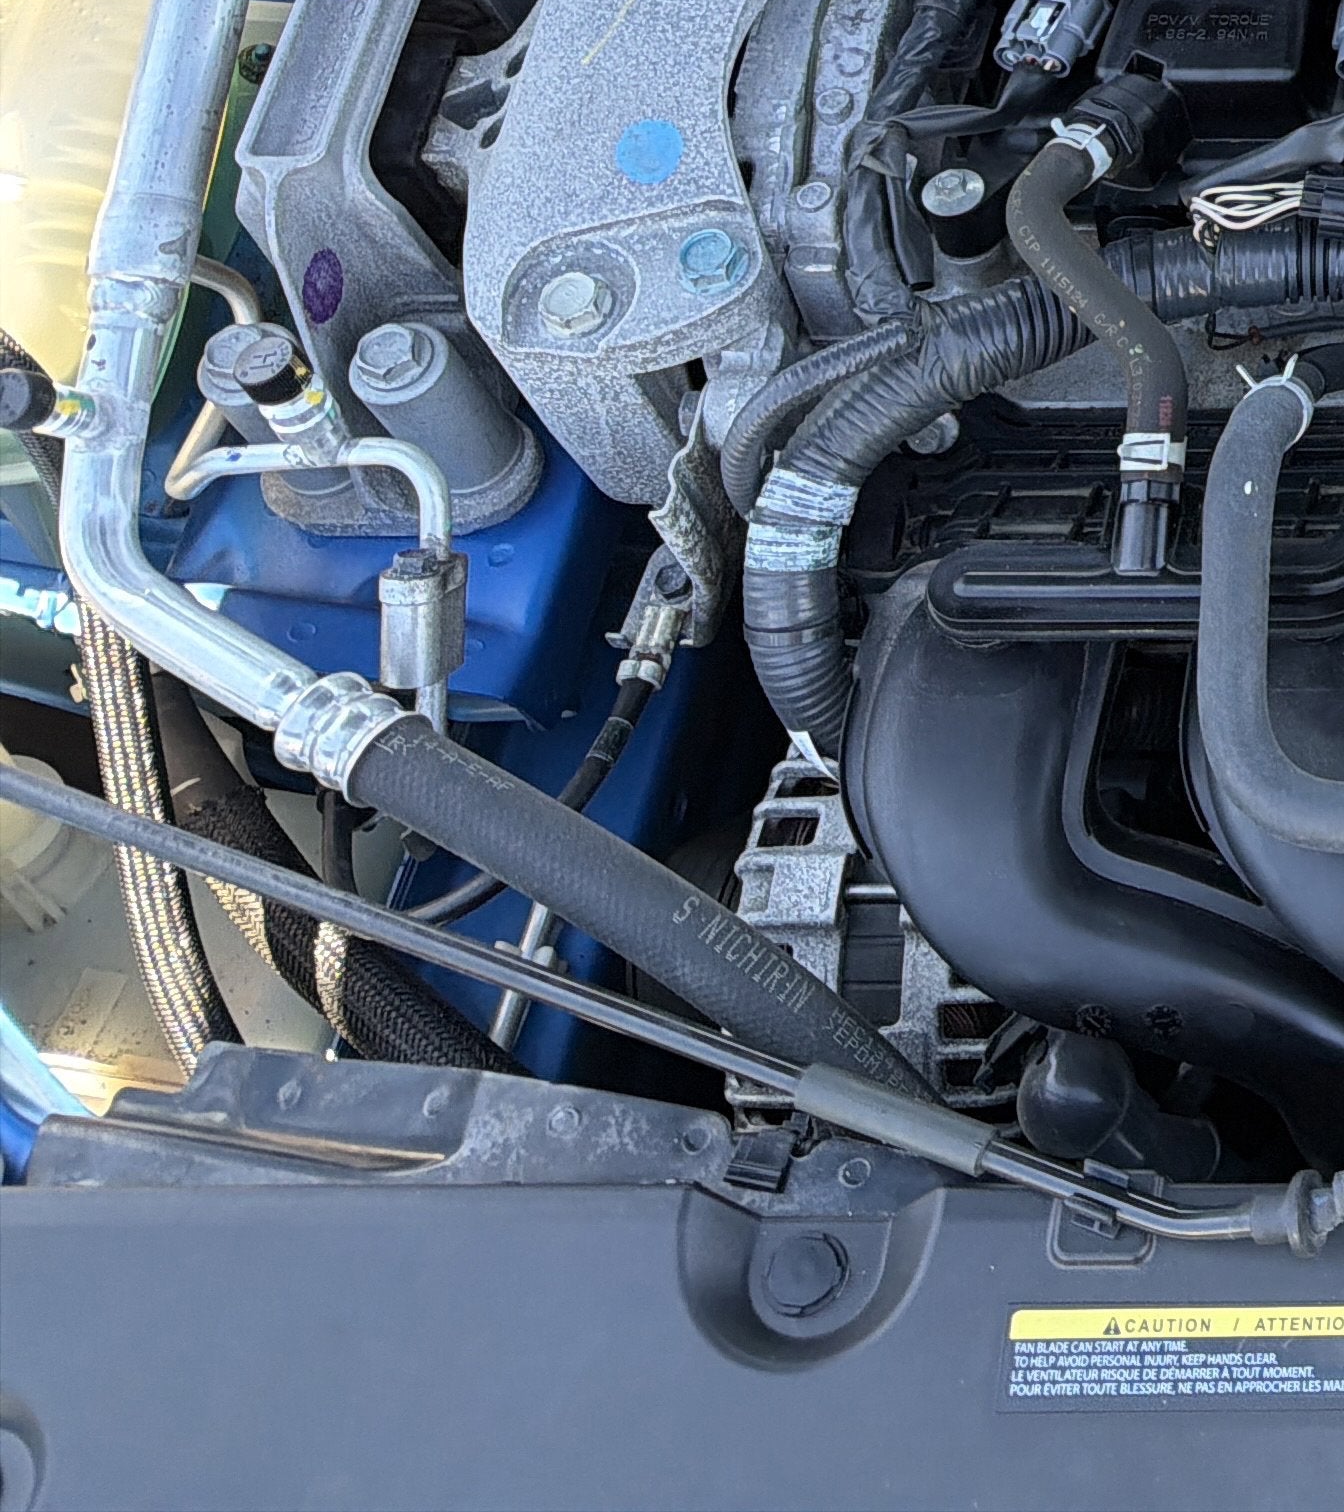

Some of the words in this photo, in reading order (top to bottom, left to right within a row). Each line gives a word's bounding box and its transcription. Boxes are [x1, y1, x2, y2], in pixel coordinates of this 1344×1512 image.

[1209, 13, 1270, 25] TORQUE
[1013, 223, 1045, 255] CIP
[1125, 1318, 1211, 1333] CAUTION
[1015, 1342, 1036, 1353] FAN
[1037, 1342, 1069, 1353] BLADE
[1071, 1341, 1093, 1353] CAN
[1095, 1341, 1125, 1352] START
[1126, 1341, 1139, 1352] AT
[1140, 1341, 1162, 1352] ANY
[1163, 1340, 1188, 1352] TIME.
[1014, 1356, 1028, 1367] TO
[1030, 1356, 1056, 1367] HELP
[1057, 1356, 1089, 1367] AVOID
[1091, 1355, 1142, 1366] PERSONAL
[1182, 1354, 1205, 1365] KEEP
[1207, 1354, 1243, 1365] HANDS
[1244, 1353, 1278, 1365] CLEAR.
[1012, 1370, 1025, 1382] LE
[1026, 1369, 1099, 1382] VENTILATEUR
[1100, 1369, 1140, 1381] RISQUE
[1143, 1368, 1158, 1380] DE
[1160, 1366, 1219, 1380] DÉMARRER
[1232, 1367, 1260, 1378] TOUT
[1262, 1366, 1315, 1378] MOMENT.
[1009, 1384, 1041, 1396] POUR
[1082, 1383, 1118, 1395] TOUTE
[1120, 1383, 1176, 1395] BLESSURE,
[1178, 1382, 1193, 1394] NE
[1195, 1382, 1215, 1393] PAS
[1218, 1381, 1232, 1393] EN
[1235, 1381, 1301, 1393] APPROCHER
[1302, 1381, 1321, 1392] LES
